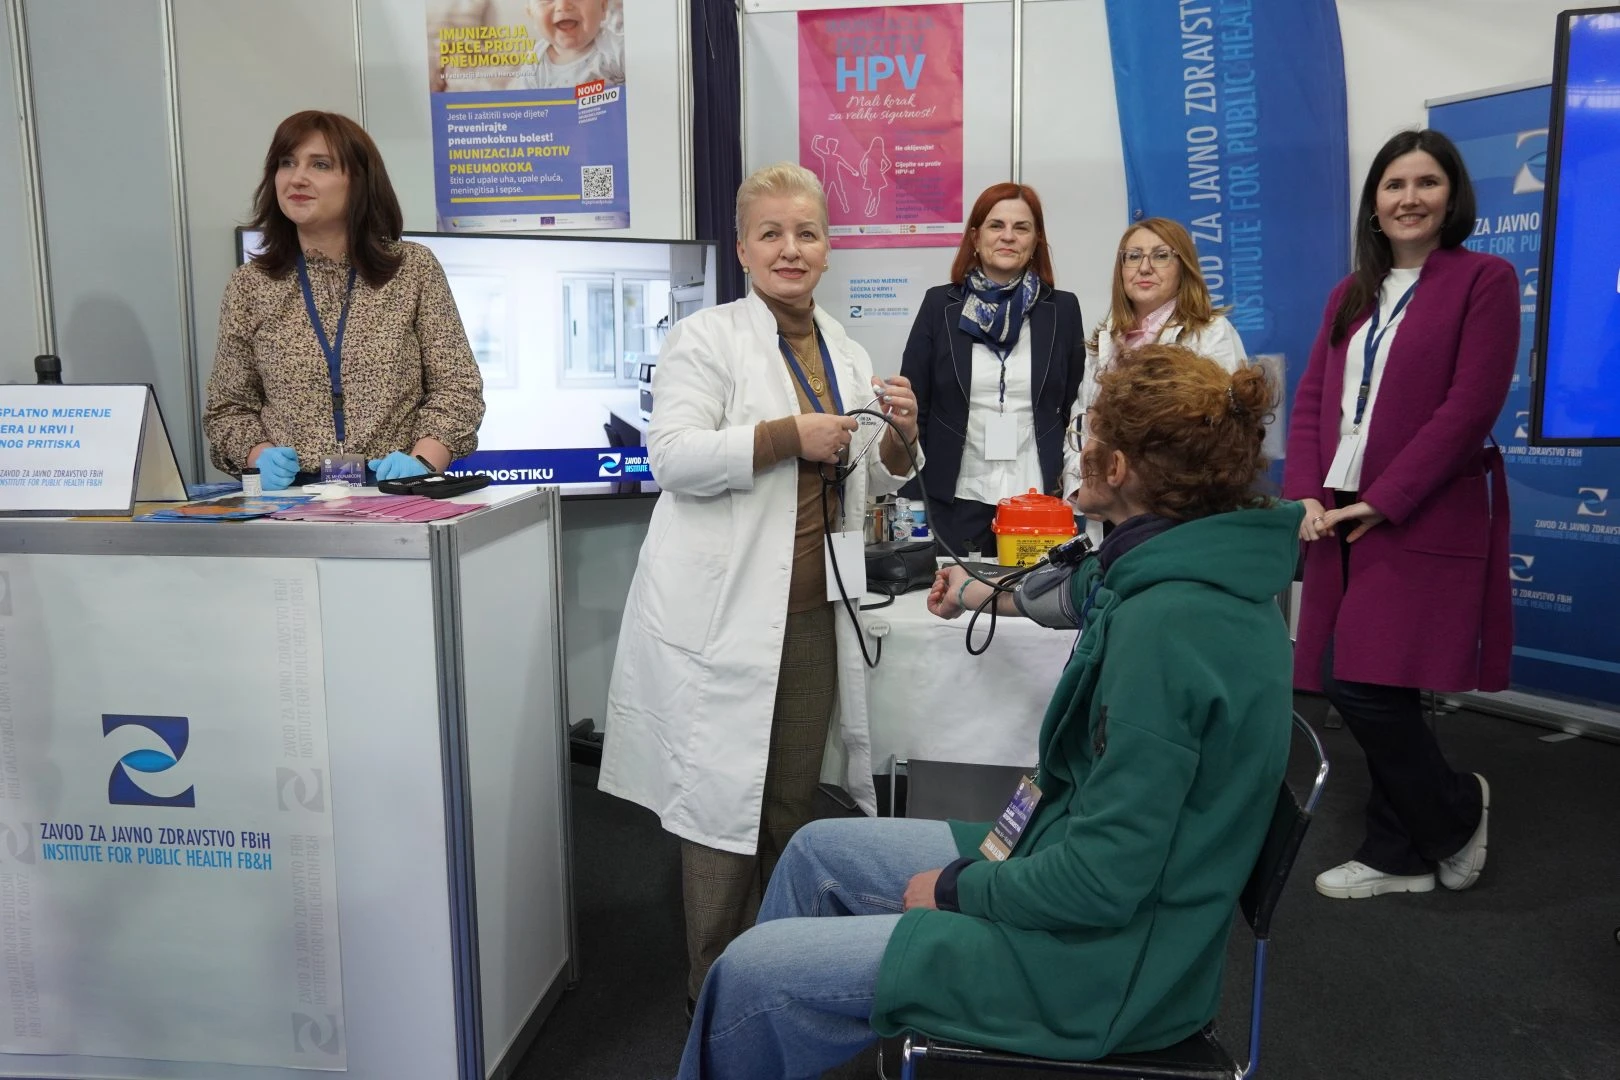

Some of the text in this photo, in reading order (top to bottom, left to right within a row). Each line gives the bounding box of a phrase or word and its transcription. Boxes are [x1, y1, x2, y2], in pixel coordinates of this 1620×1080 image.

[440, 24, 528, 40] IMUNIZACIJA
[441, 38, 535, 55] DJECE PROTIV
[836, 34, 925, 56] PROTIV
[441, 51, 539, 68] PNEUMOKOKA
[836, 53, 926, 92] HPV
[577, 83, 602, 97] NOVO
[581, 90, 617, 106] CJEPIVO
[846, 93, 916, 108] Mali korak
[448, 109, 549, 121] Jeste li zaštitili svoje dijete?
[828, 105, 937, 125] za veliku sigurnost!
[447, 122, 508, 133] Prevenirajte
[448, 132, 553, 147] pneumokoknu bolest!
[449, 145, 570, 160] IMUNIZACIJA PROTIV
[449, 162, 533, 174] PNEUMOKOKA
[1186, 126, 1221, 203] JAVNO
[1220, 0, 1264, 331] INSTITUTE FOR PUBLIC HEAL
[450, 172, 563, 185] štiti od upale uha, upale pluća,
[450, 186, 494, 196] meningitisa
[499, 186, 524, 195] sepse.
[1191, 212, 1222, 244] ZA
[1474, 212, 1540, 236] ZA JAVNO
[1488, 236, 1515, 255] FOR
[1520, 233, 1542, 253] PU
[52, 408, 111, 418] MJERENJE
[0, 424, 74, 434] ERA U KRVI I
[27, 439, 81, 449] PRITISKA
[625, 456, 642, 465] ZAVOD
[22, 469, 30, 478] ZA
[31, 469, 52, 478] JAVNO
[53, 469, 88, 478] ZDRAVSTVO
[625, 464, 648, 473] INSTITUTE
[28, 478, 40, 487] FOR
[41, 478, 61, 487] PUBLIC
[63, 479, 85, 487] HEALTH
[1535, 519, 1557, 529] ZAVOD
[1557, 520, 1568, 530] ZA
[1569, 522, 1590, 533] JAVNO
[40, 822, 271, 849] ZAVOD ZA JAVNO ZDRAVSTVO FBiH
[43, 843, 273, 870] INSTITUTE FOR PUBLIC HEALTH FB&H
